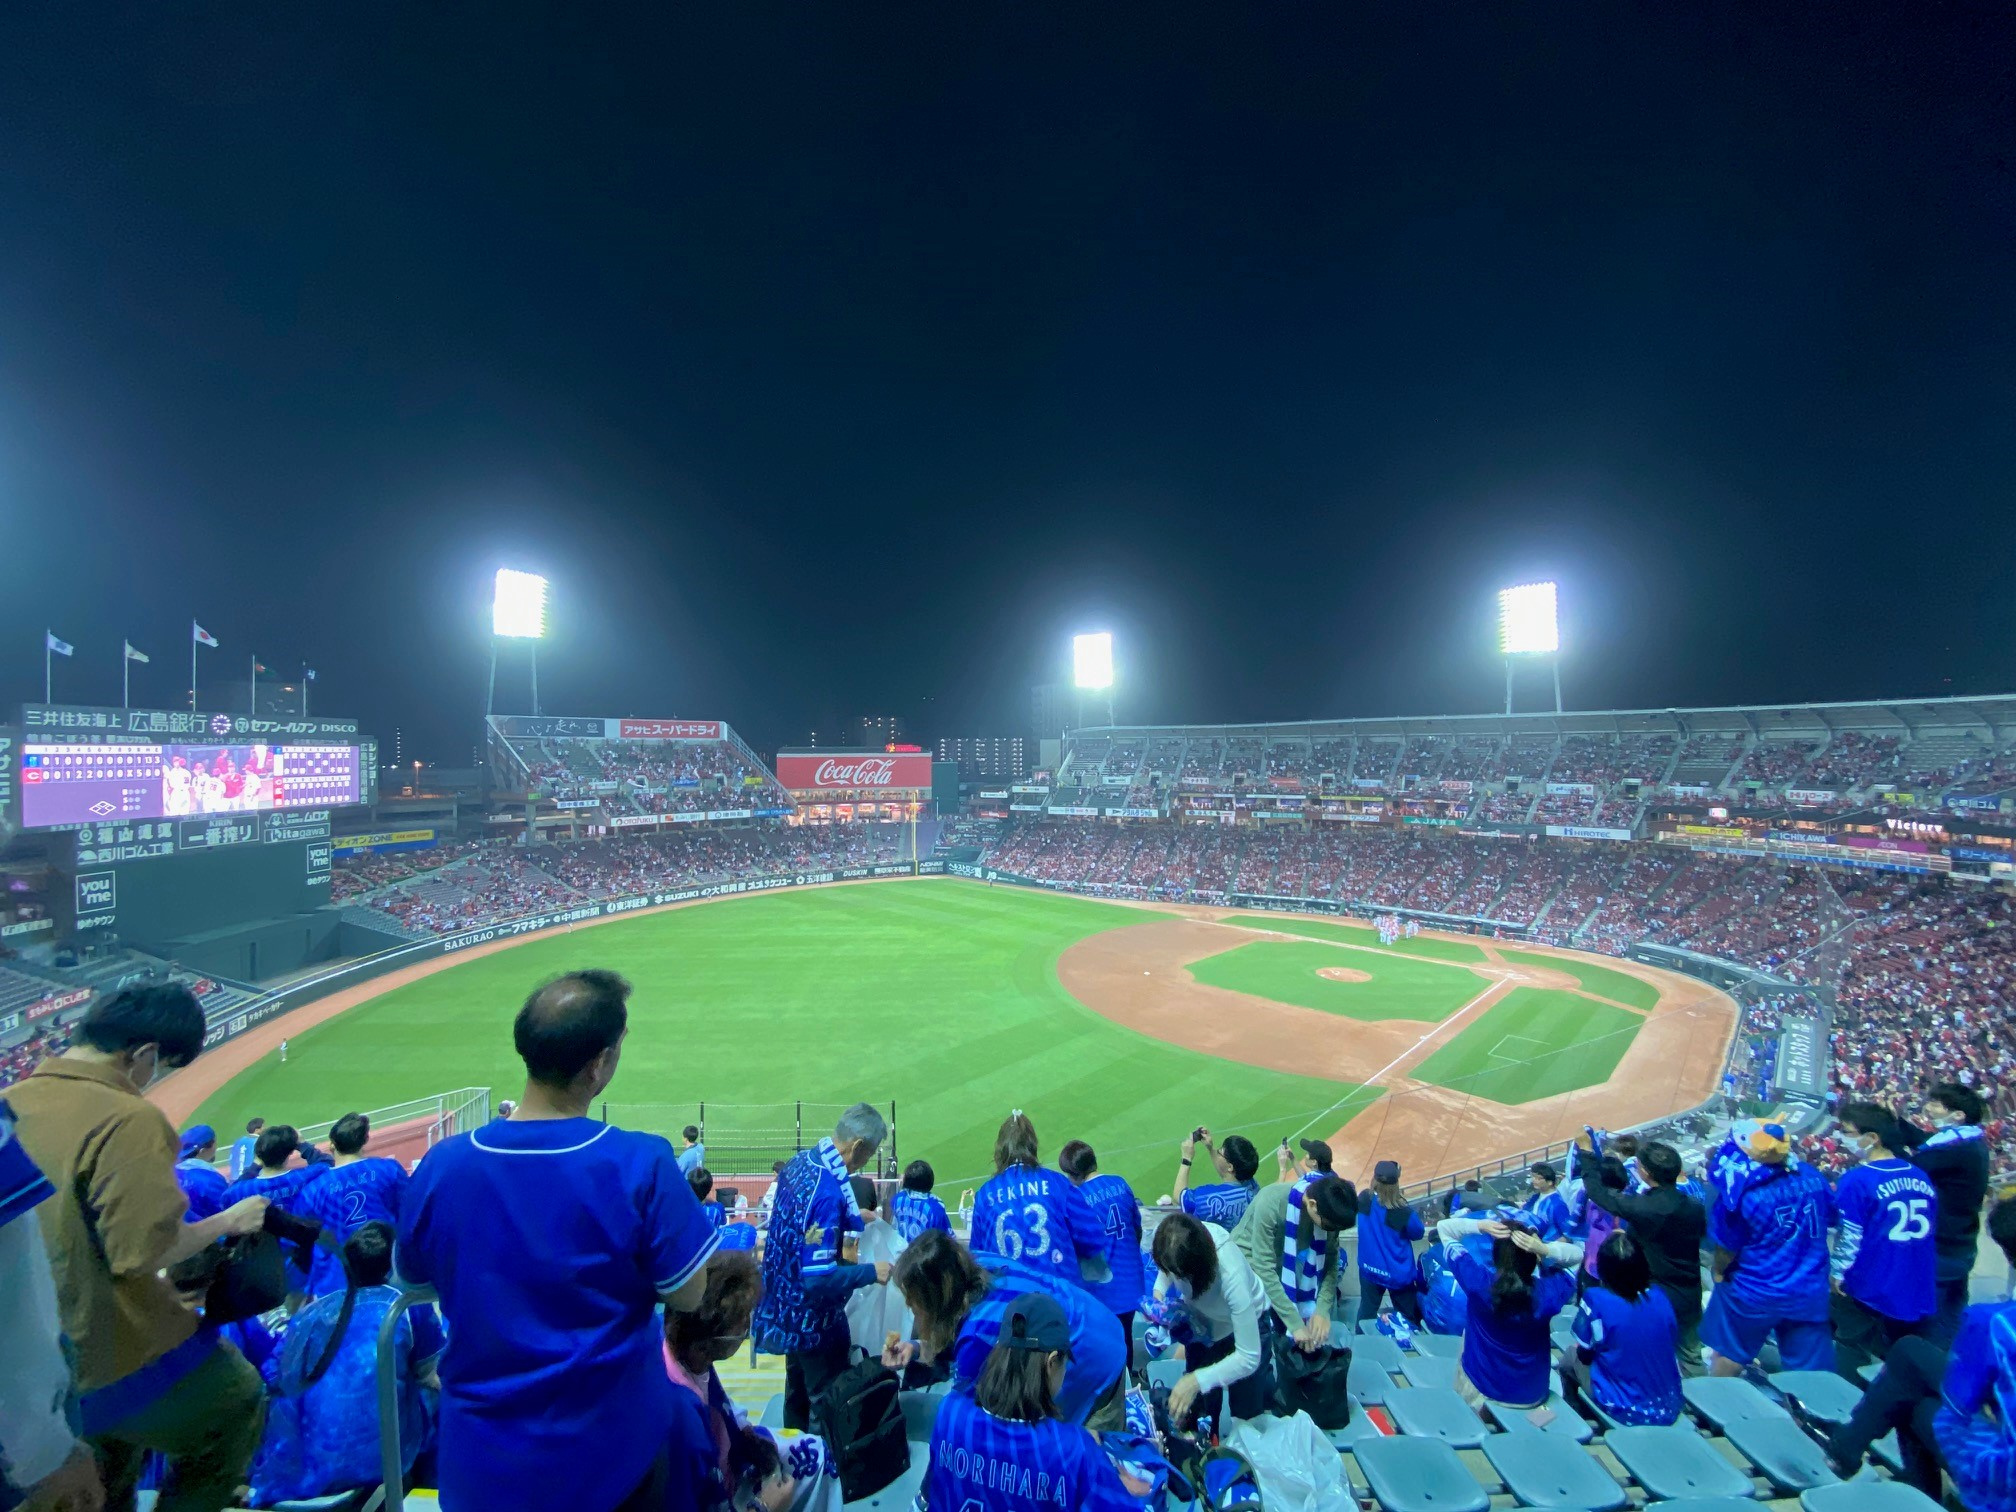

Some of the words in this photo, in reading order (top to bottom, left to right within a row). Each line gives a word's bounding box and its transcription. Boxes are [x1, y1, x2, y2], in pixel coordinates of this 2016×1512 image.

[26, 710, 122, 728] 三井住友海上
[128, 711, 208, 733] 広島銀行
[321, 723, 357, 733] DISCO
[814, 758, 897, 786] Coca-Cola
[209, 818, 233, 827] KIRIN
[1886, 818, 1943, 833] Victory
[188, 824, 252, 845] 一番搾り
[1574, 830, 1611, 838] HIROTEC
[1779, 832, 1828, 843] ICHIKAWA
[98, 841, 174, 863] 西川ゴム工業
[310, 848, 328, 860] you
[313, 856, 329, 867] me
[843, 869, 868, 877] DUSKIN
[81, 879, 110, 896] you
[664, 890, 699, 902] SUZUKI
[86, 890, 112, 904] me
[511, 917, 551, 934] フマキラー
[444, 930, 494, 951] SAKURAO
[987, 1180, 1050, 1206] SEKINE
[343, 1190, 368, 1228] 2
[1105, 1202, 1127, 1240] 4
[1887, 1199, 1930, 1241] 25
[996, 1202, 1051, 1261] 63
[939, 1440, 1066, 1507] MORIHARA
